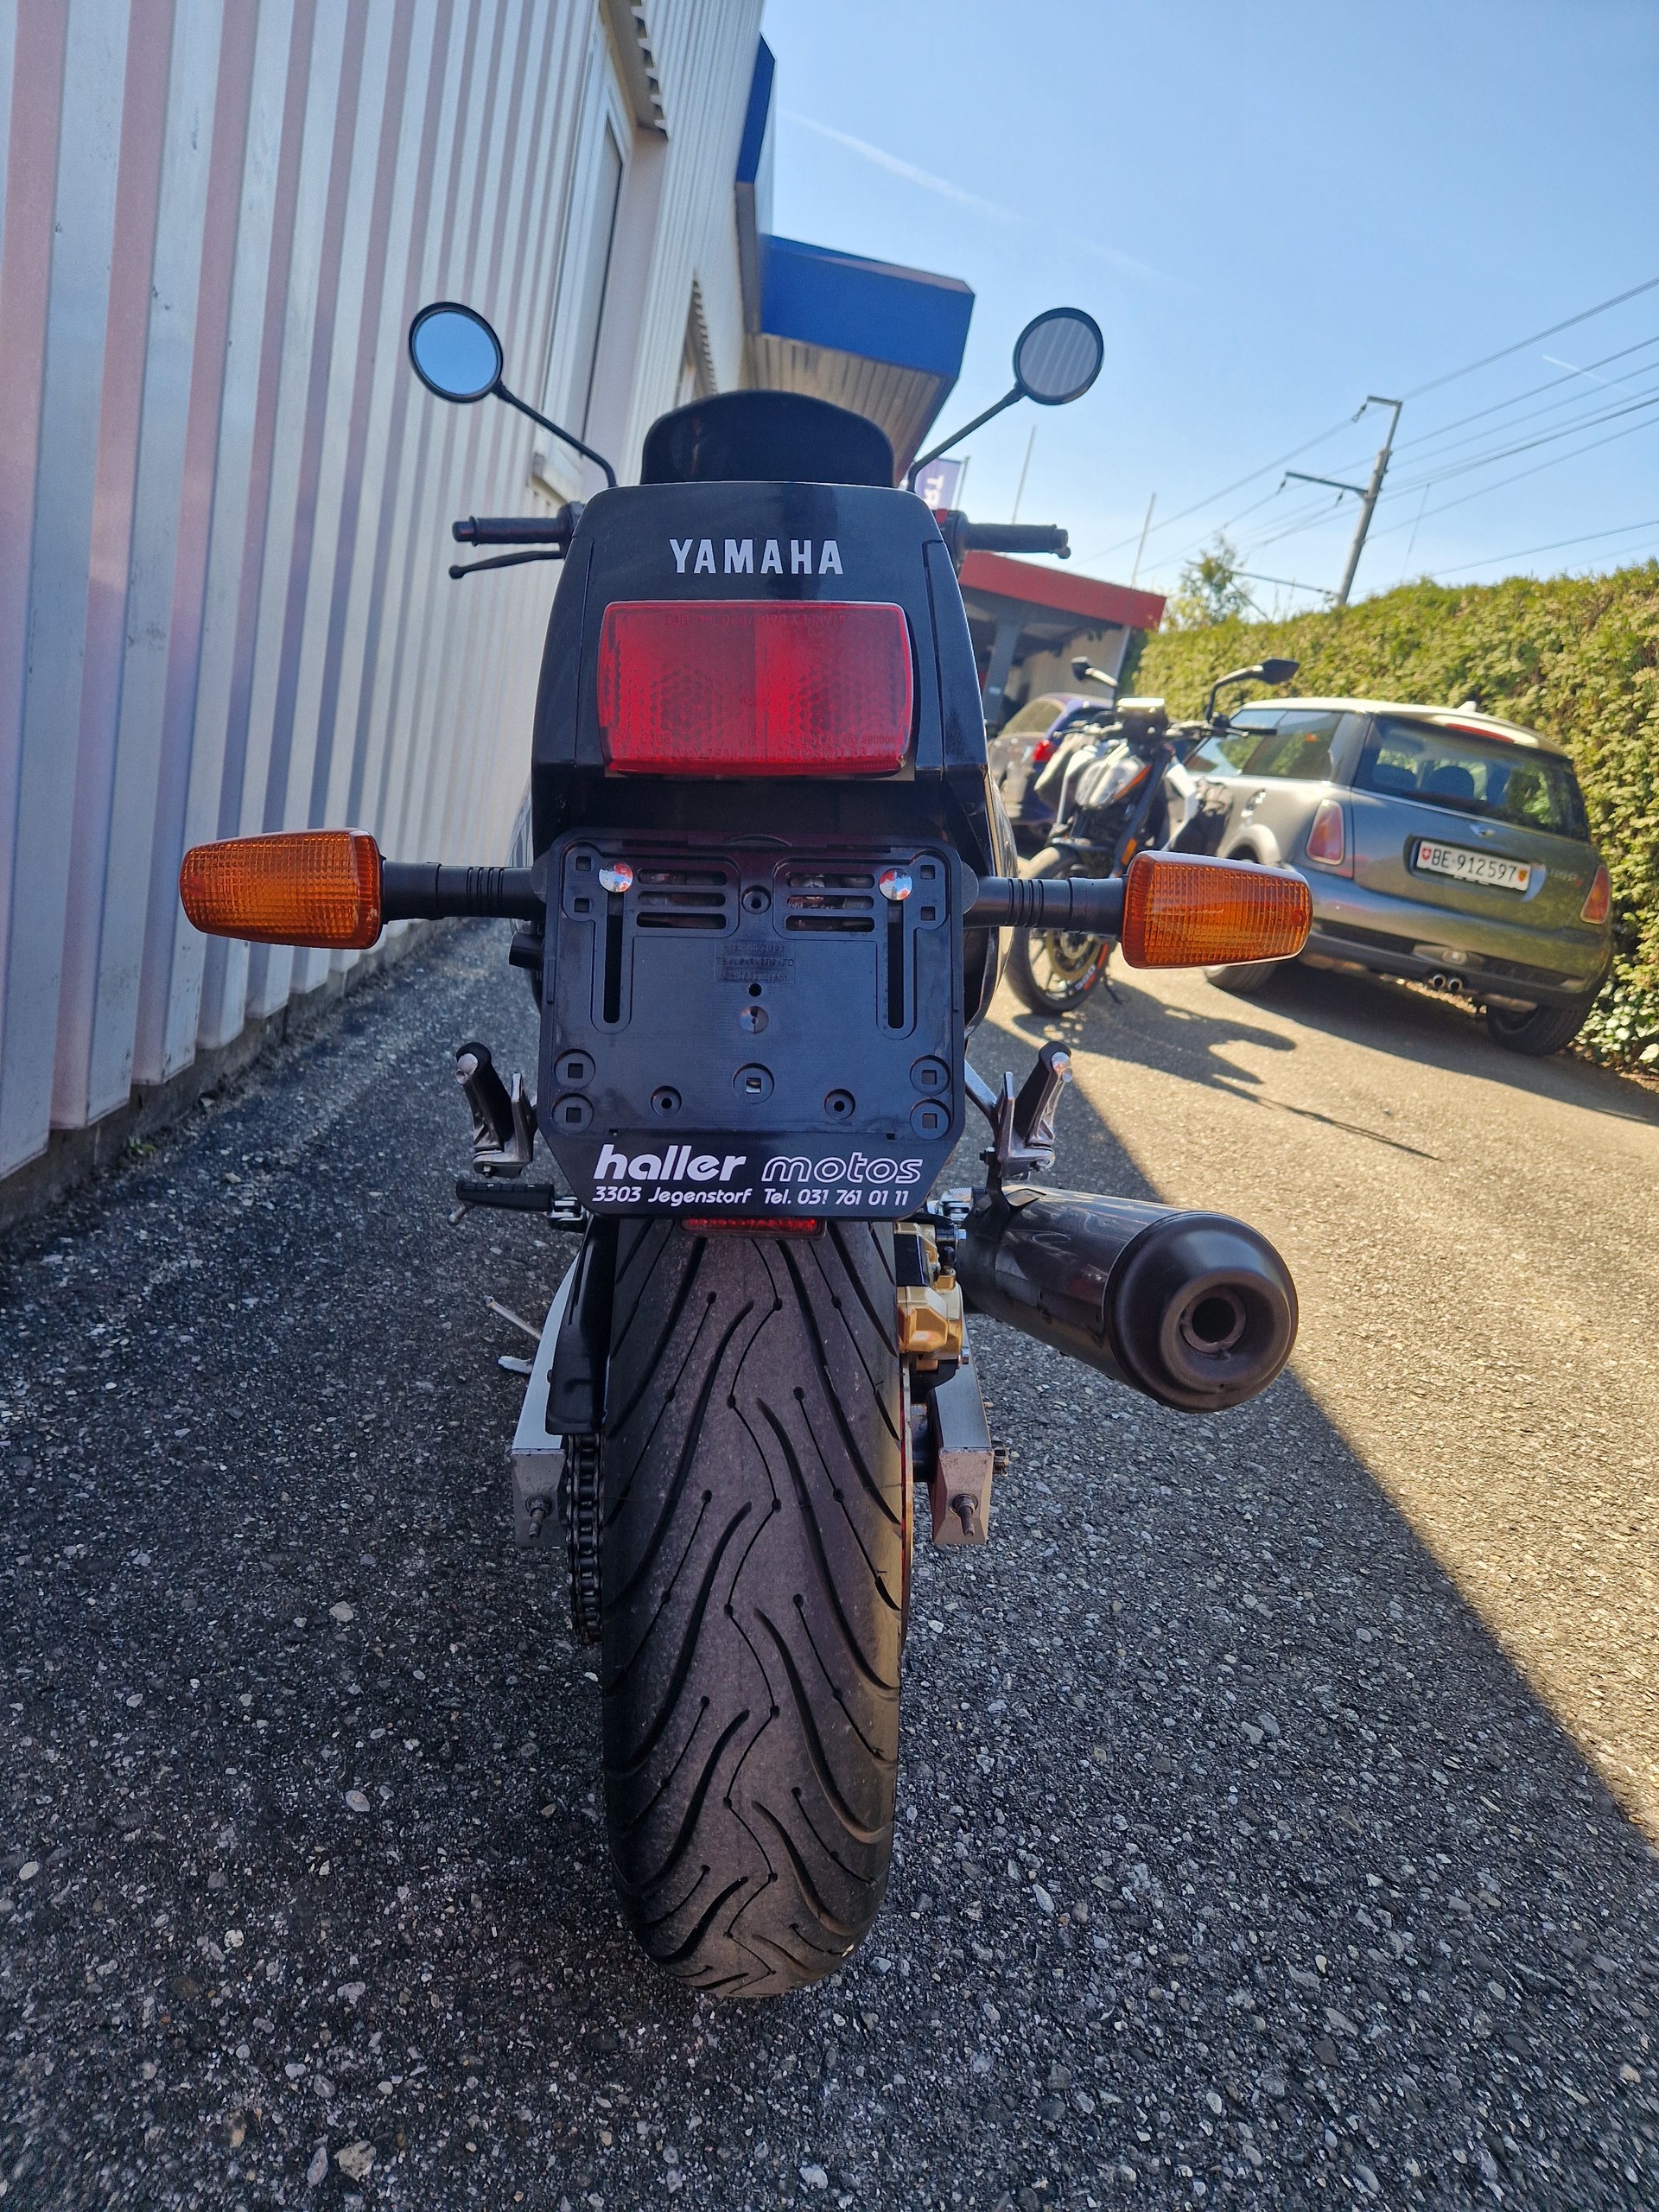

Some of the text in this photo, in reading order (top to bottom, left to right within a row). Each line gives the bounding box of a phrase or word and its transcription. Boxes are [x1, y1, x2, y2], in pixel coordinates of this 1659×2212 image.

[669, 538, 844, 575] YAMAHA
[593, 1144, 924, 1184] haller motos
[592, 1185, 910, 1206] 3303 Jegenstorf Tel. 031 761 01 11
